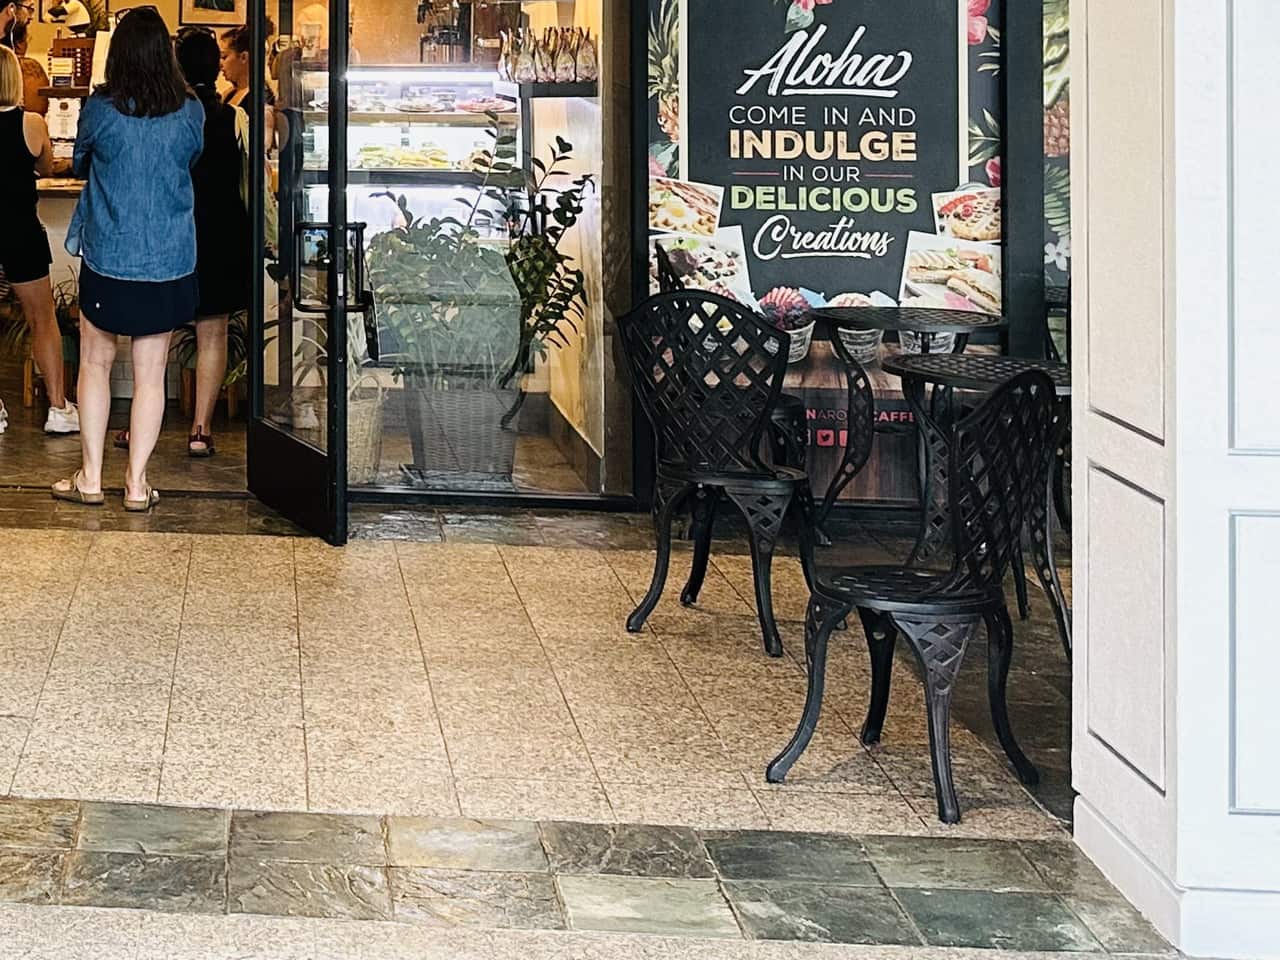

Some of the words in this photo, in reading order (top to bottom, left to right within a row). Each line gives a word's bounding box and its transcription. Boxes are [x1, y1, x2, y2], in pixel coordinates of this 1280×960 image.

[735, 24, 913, 98] Aloha
[729, 106, 806, 126] COME
[824, 106, 849, 126] IN
[858, 107, 917, 127] AND
[729, 128, 918, 162] INDULGE
[783, 165, 804, 180] IN
[811, 166, 861, 183] OUR
[730, 186, 918, 213] DELICIOUS
[752, 215, 895, 260] Creations
